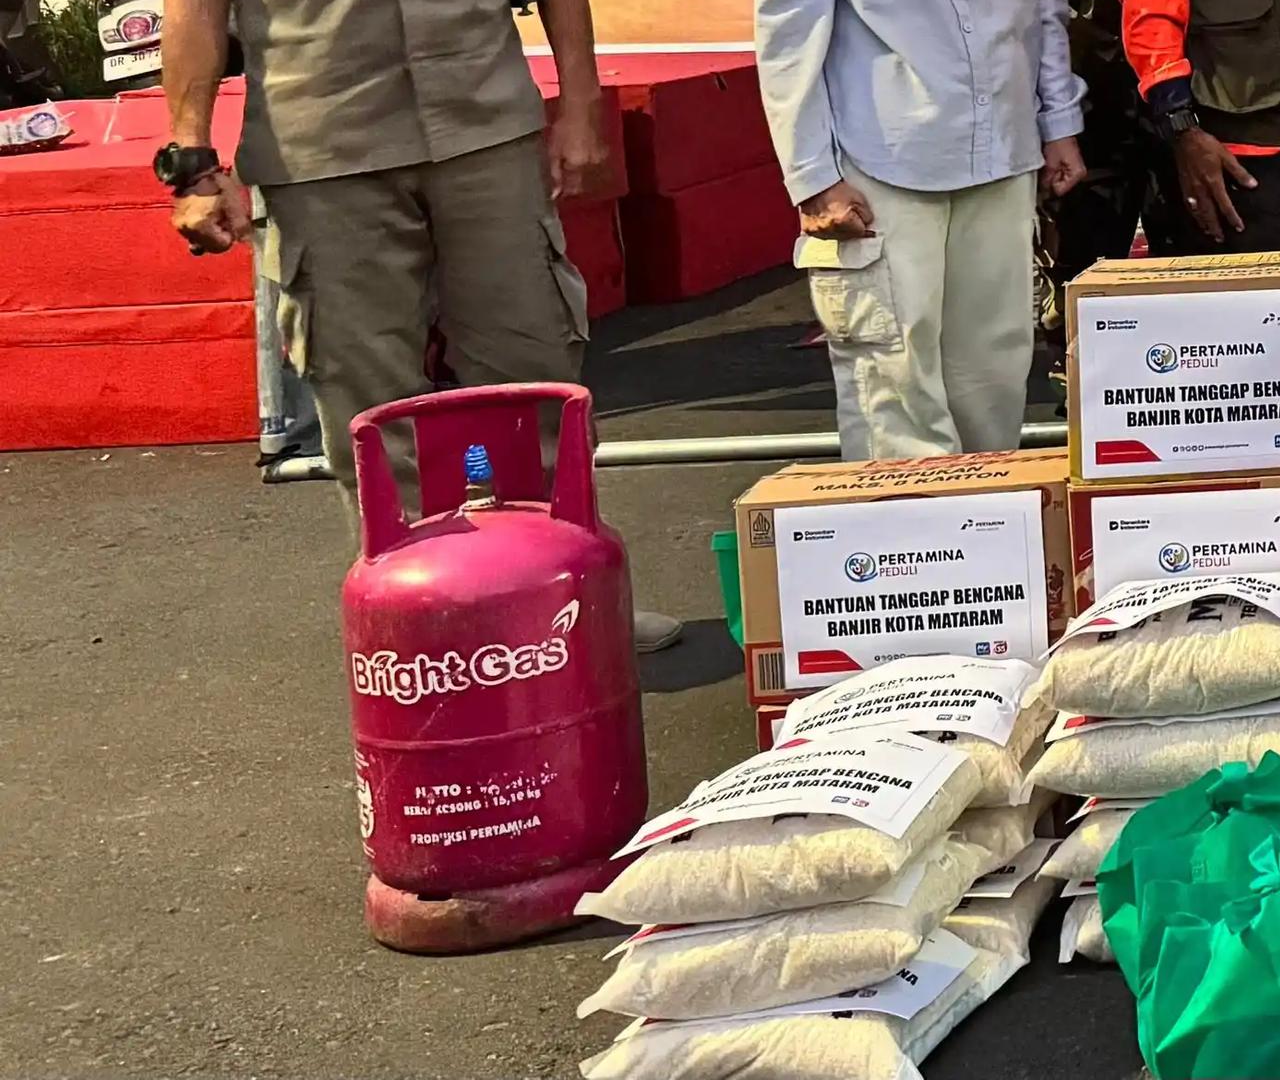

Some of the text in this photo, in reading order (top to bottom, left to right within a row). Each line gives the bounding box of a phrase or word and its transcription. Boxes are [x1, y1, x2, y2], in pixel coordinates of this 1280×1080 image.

[1179, 342, 1266, 358] PERTAMINA
[1179, 358, 1219, 369] PEDULI
[1103, 386, 1176, 406] BANTUAN
[1179, 383, 1250, 402] TANGGAP
[1126, 408, 1180, 427] BANJIR
[1184, 406, 1224, 425] KOTA
[855, 464, 984, 482] TUMPUKAN
[915, 470, 1010, 484] KARTON
[878, 548, 965, 566] PERTAMINA
[1192, 541, 1278, 558] PERTAMINA
[878, 565, 919, 578] PEDULI
[1192, 557, 1232, 569] PEDULI
[803, 583, 1025, 616] BANTUAN TANGGAP BENCANA
[826, 608, 1004, 638] BANJIR KOTA MATARAM
[352, 636, 569, 705] Bright Gas
[895, 697, 978, 713] MATARAM
[924, 687, 1006, 705] BENCANA
[745, 780, 796, 797] KOTA
[797, 777, 881, 795] MATARAM
[752, 767, 914, 790] TANGGAP BENCANA
[526, 788, 541, 800] kg
